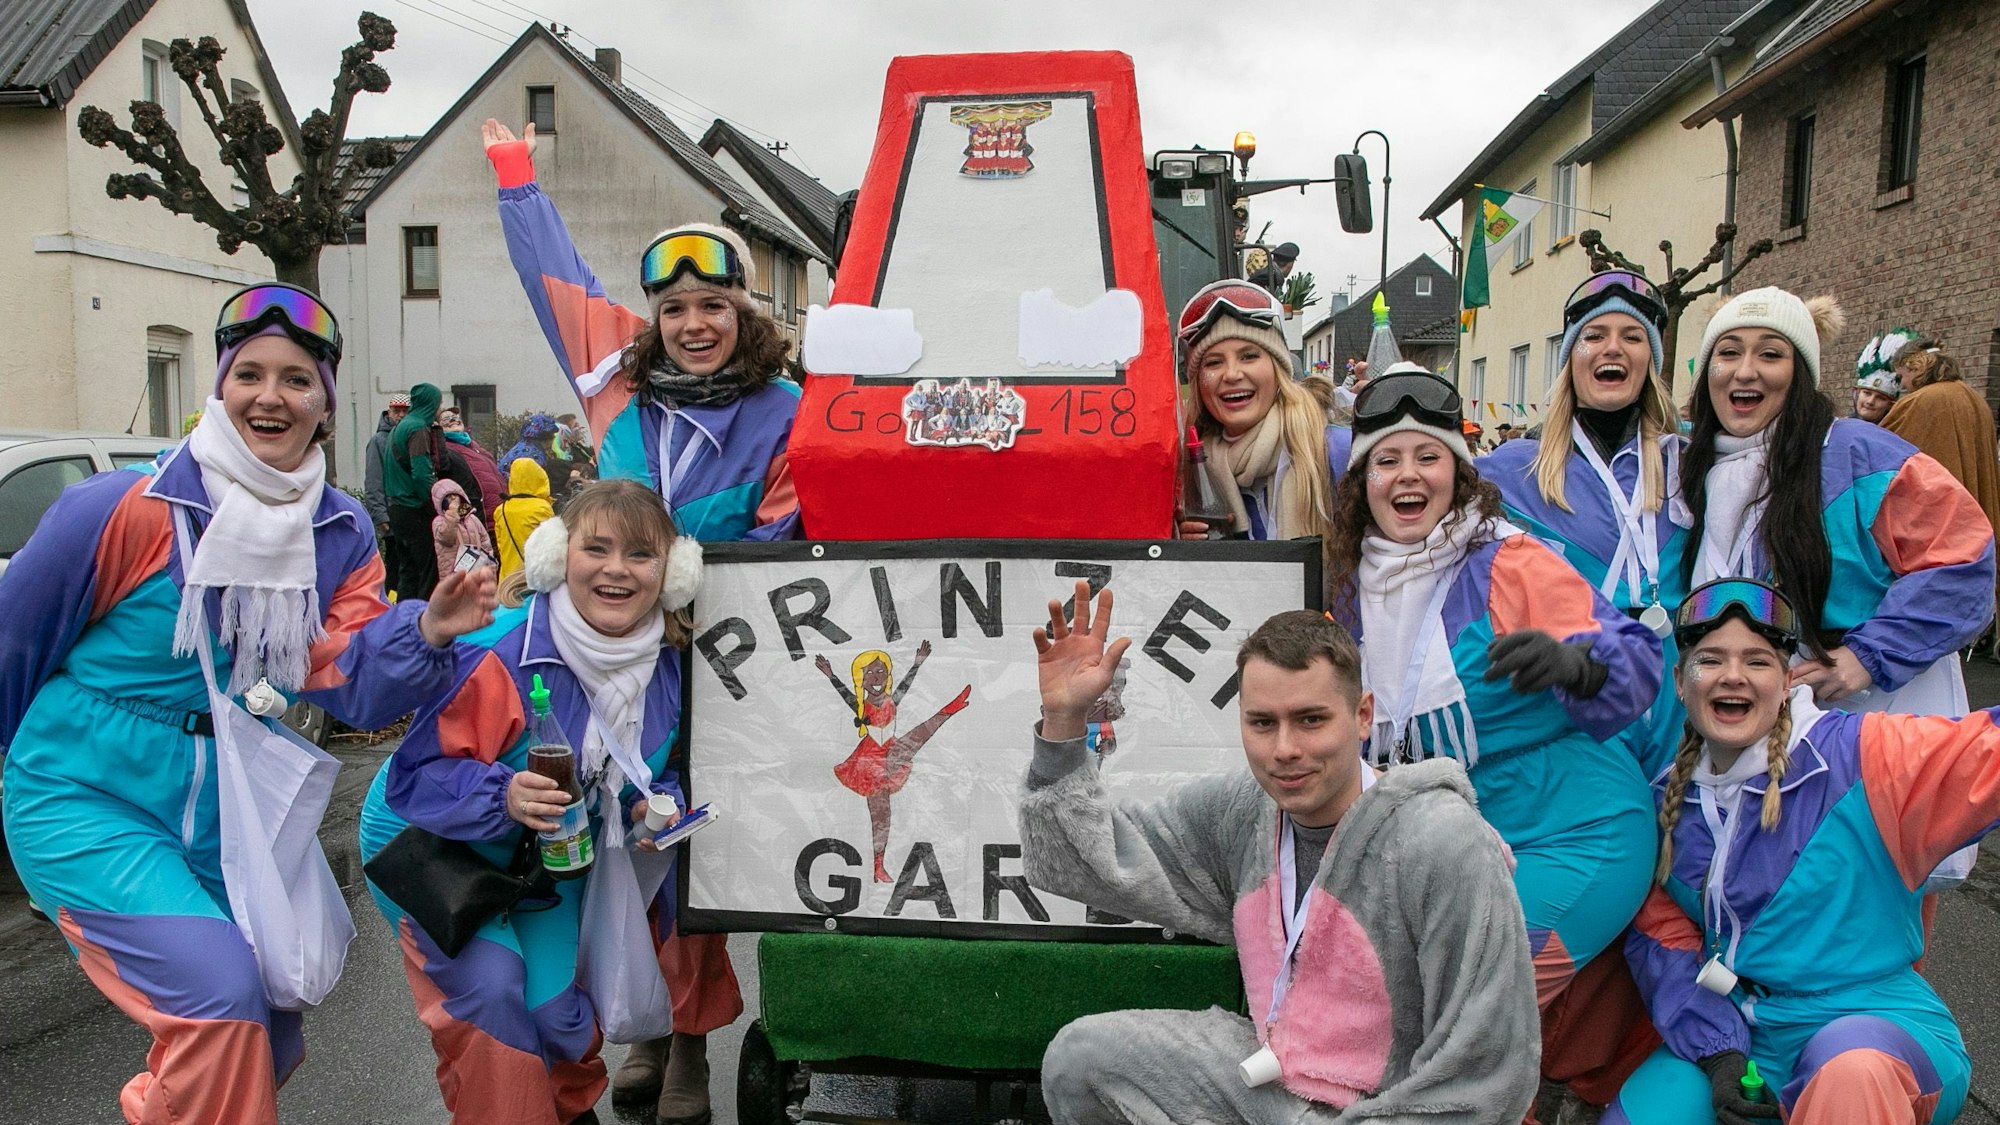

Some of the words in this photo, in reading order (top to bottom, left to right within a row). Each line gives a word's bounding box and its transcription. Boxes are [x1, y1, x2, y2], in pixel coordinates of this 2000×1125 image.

[1050, 388, 1136, 437] 158
[694, 561, 1240, 711] PRINZE
[794, 838, 1136, 924] GAR
